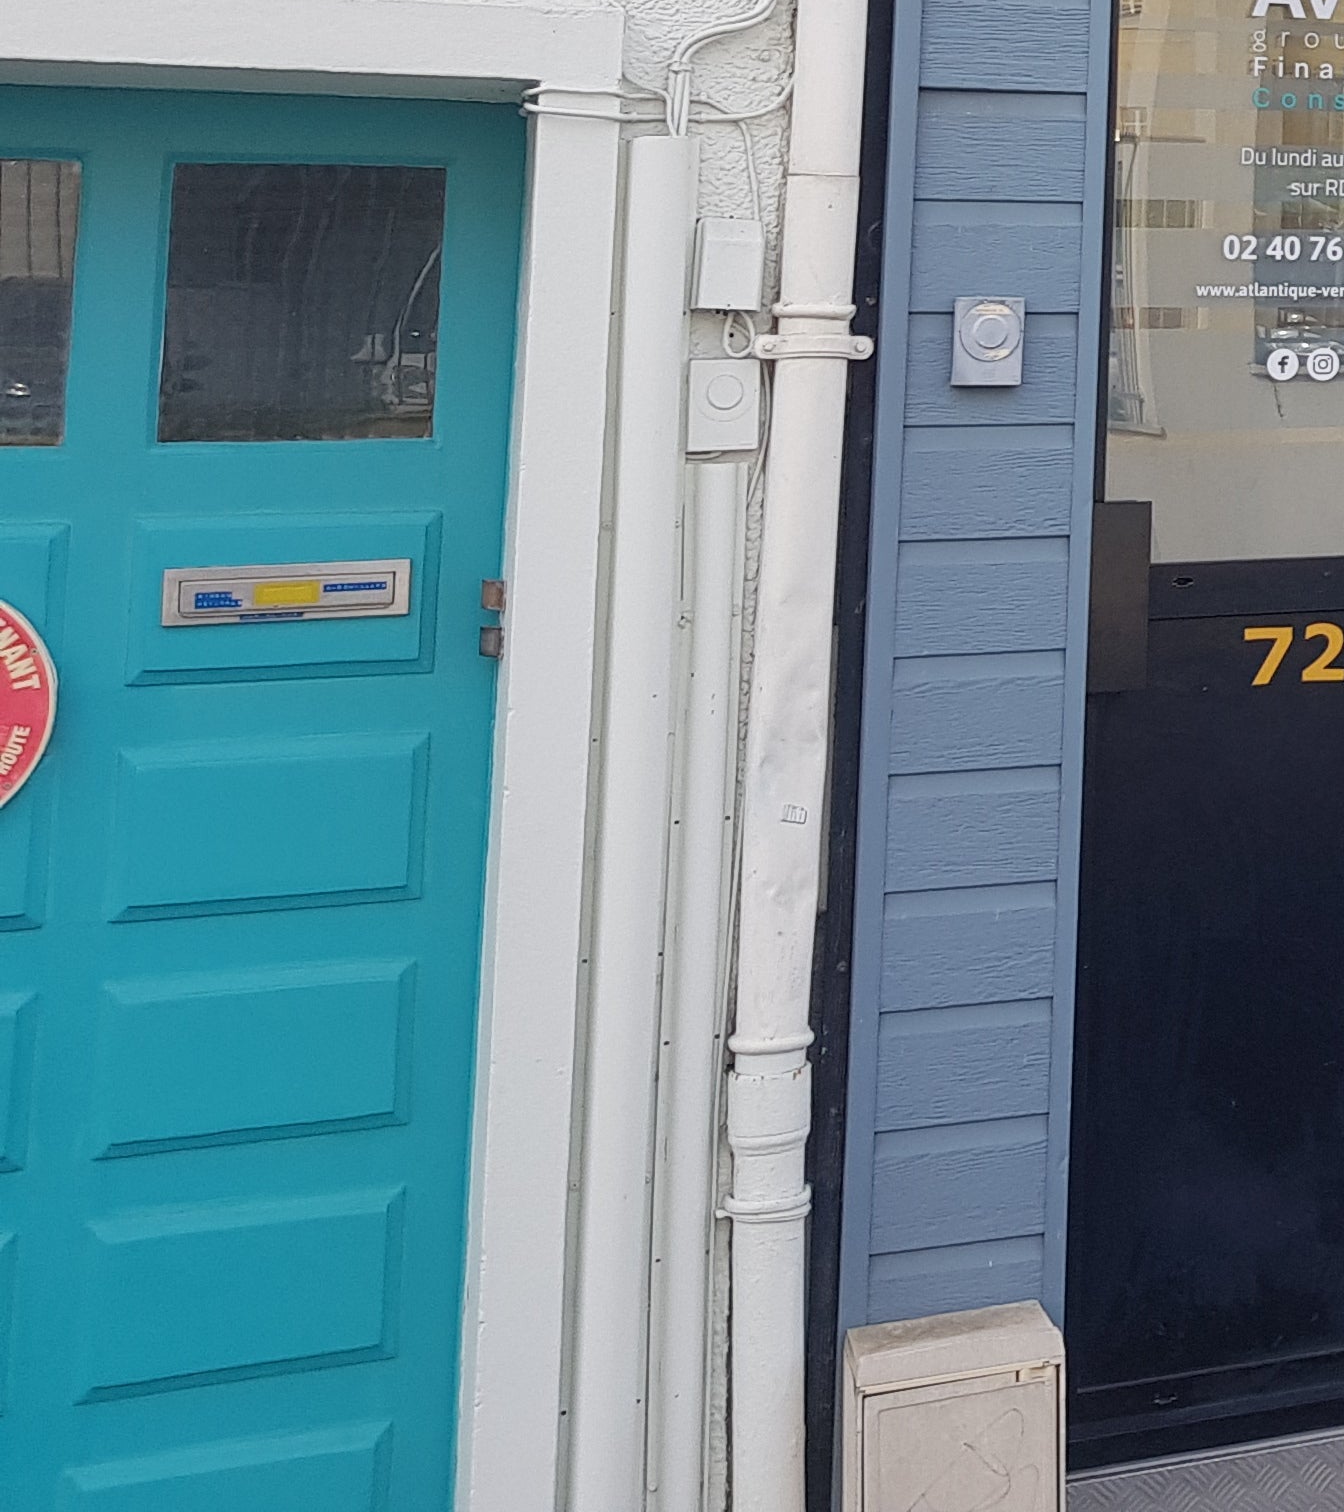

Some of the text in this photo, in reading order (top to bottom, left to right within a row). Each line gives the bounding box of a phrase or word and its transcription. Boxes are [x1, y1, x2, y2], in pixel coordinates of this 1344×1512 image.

[1241, 148, 1266, 165] Du
[1272, 148, 1317, 167] lundi
[1322, 153, 1344, 167] au
[1290, 183, 1320, 197] sur
[1223, 235, 1258, 260] 02
[1266, 235, 1301, 260] 40
[1309, 236, 1343, 261] 76
